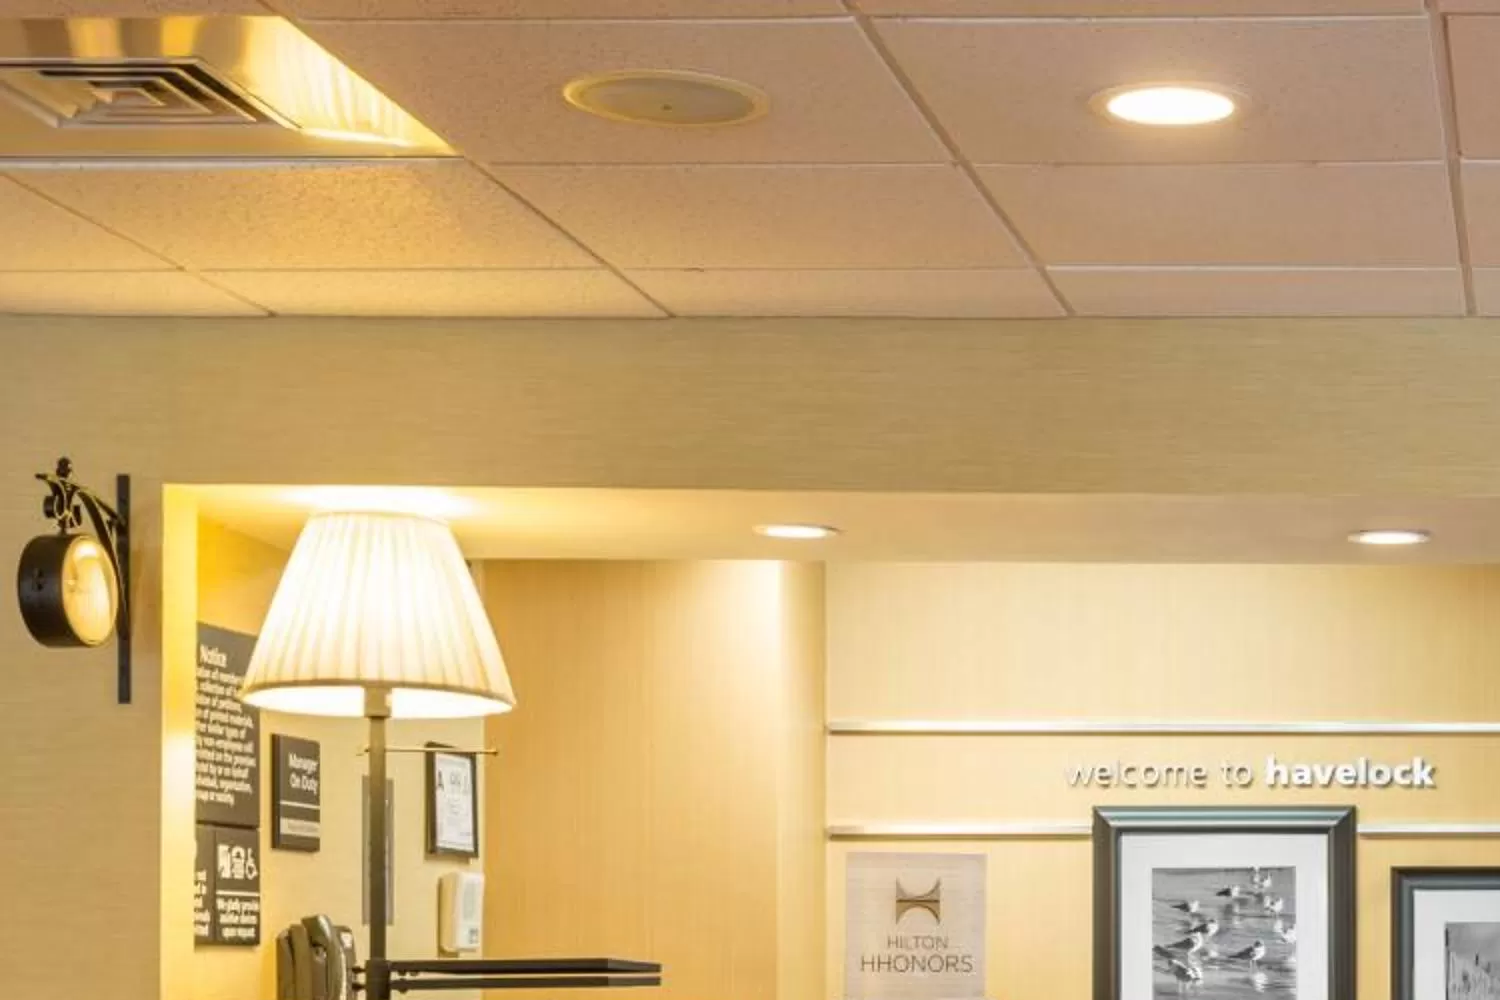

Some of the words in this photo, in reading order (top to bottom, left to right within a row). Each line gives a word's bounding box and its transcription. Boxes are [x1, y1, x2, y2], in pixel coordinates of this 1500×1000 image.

[1066, 760, 1207, 788] welcome
[1220, 762, 1254, 788] to
[1265, 754, 1437, 789] havelock
[886, 934, 949, 950] HILTON
[860, 953, 974, 974] HHONORS
